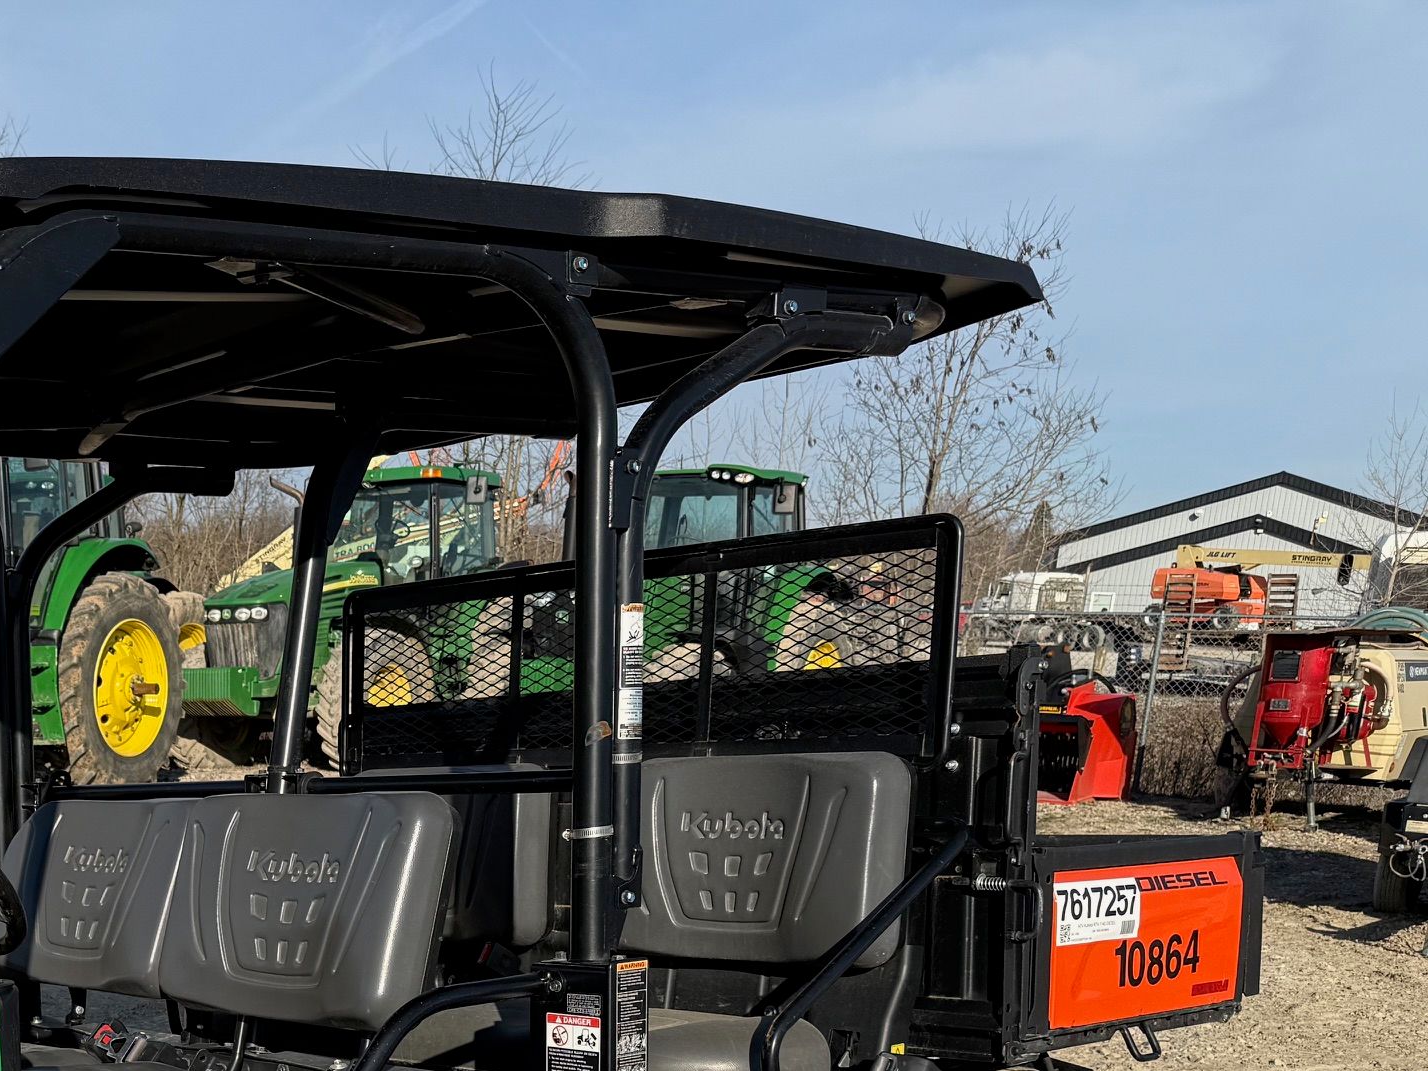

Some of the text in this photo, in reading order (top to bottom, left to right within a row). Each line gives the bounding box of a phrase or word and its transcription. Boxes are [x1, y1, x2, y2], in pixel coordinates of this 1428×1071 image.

[1291, 554, 1333, 563] STINGRAY
[681, 810, 785, 840] Kubota
[63, 845, 129, 874] Kubota
[247, 848, 341, 884] Kubota
[1136, 871, 1228, 892] DIESEL
[1056, 884, 1137, 922] 7617257
[1115, 929, 1200, 988] 10864
[563, 1018, 592, 1026] DANGER
